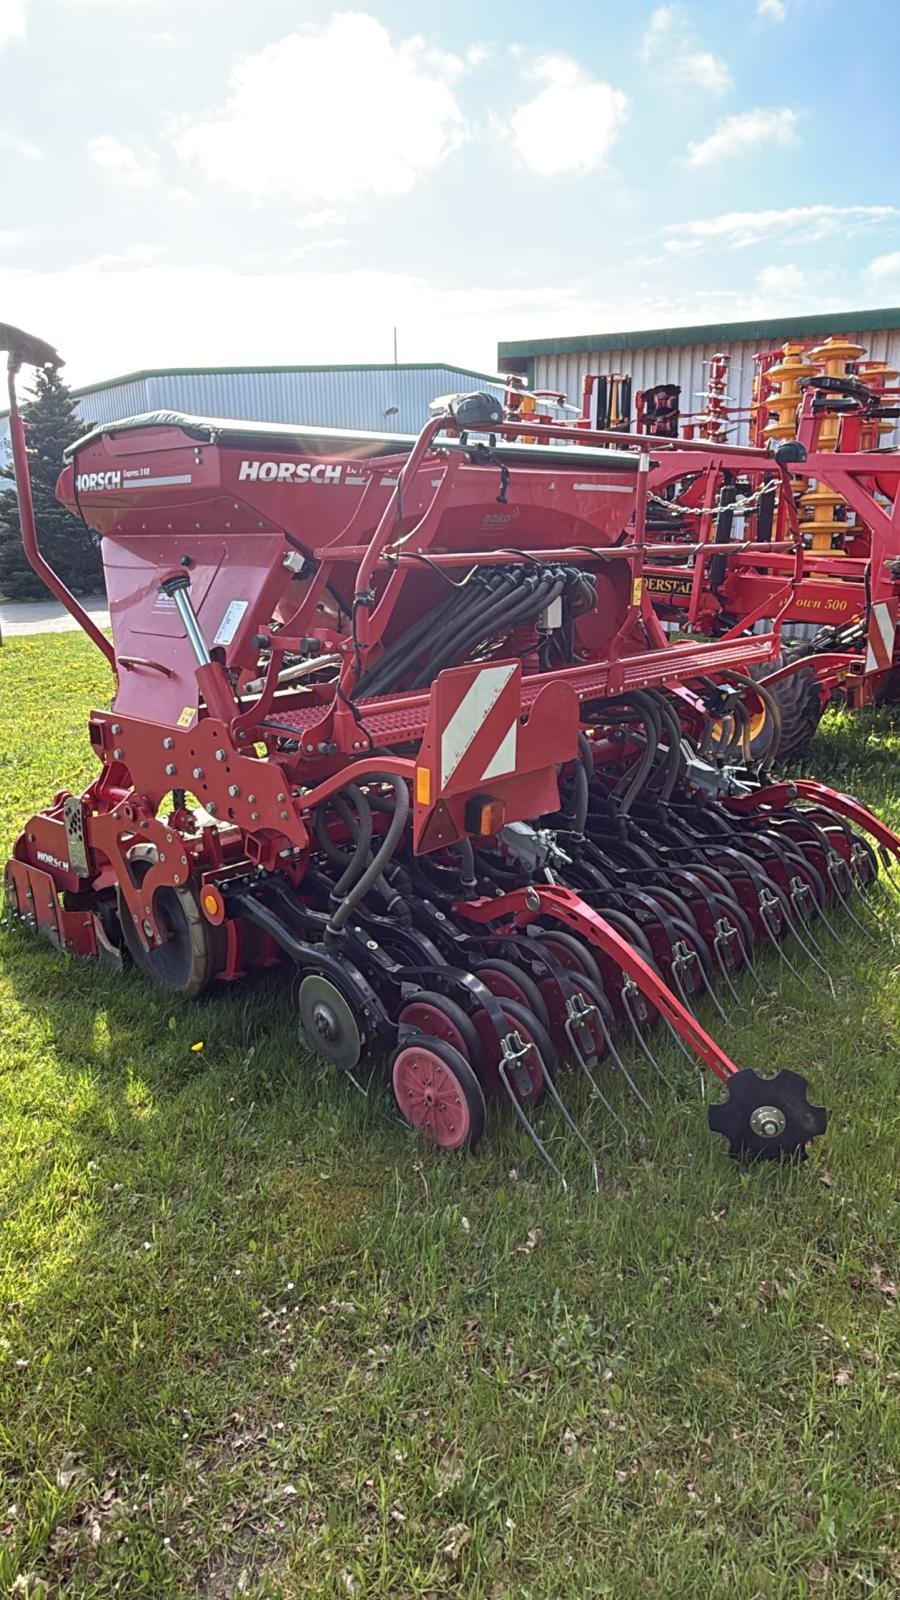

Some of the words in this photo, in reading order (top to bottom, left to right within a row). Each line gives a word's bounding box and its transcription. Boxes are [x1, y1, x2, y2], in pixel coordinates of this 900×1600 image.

[238, 460, 342, 484] HORSCH
[825, 599, 847, 611] 500
[37, 851, 69, 871] HORSCH
